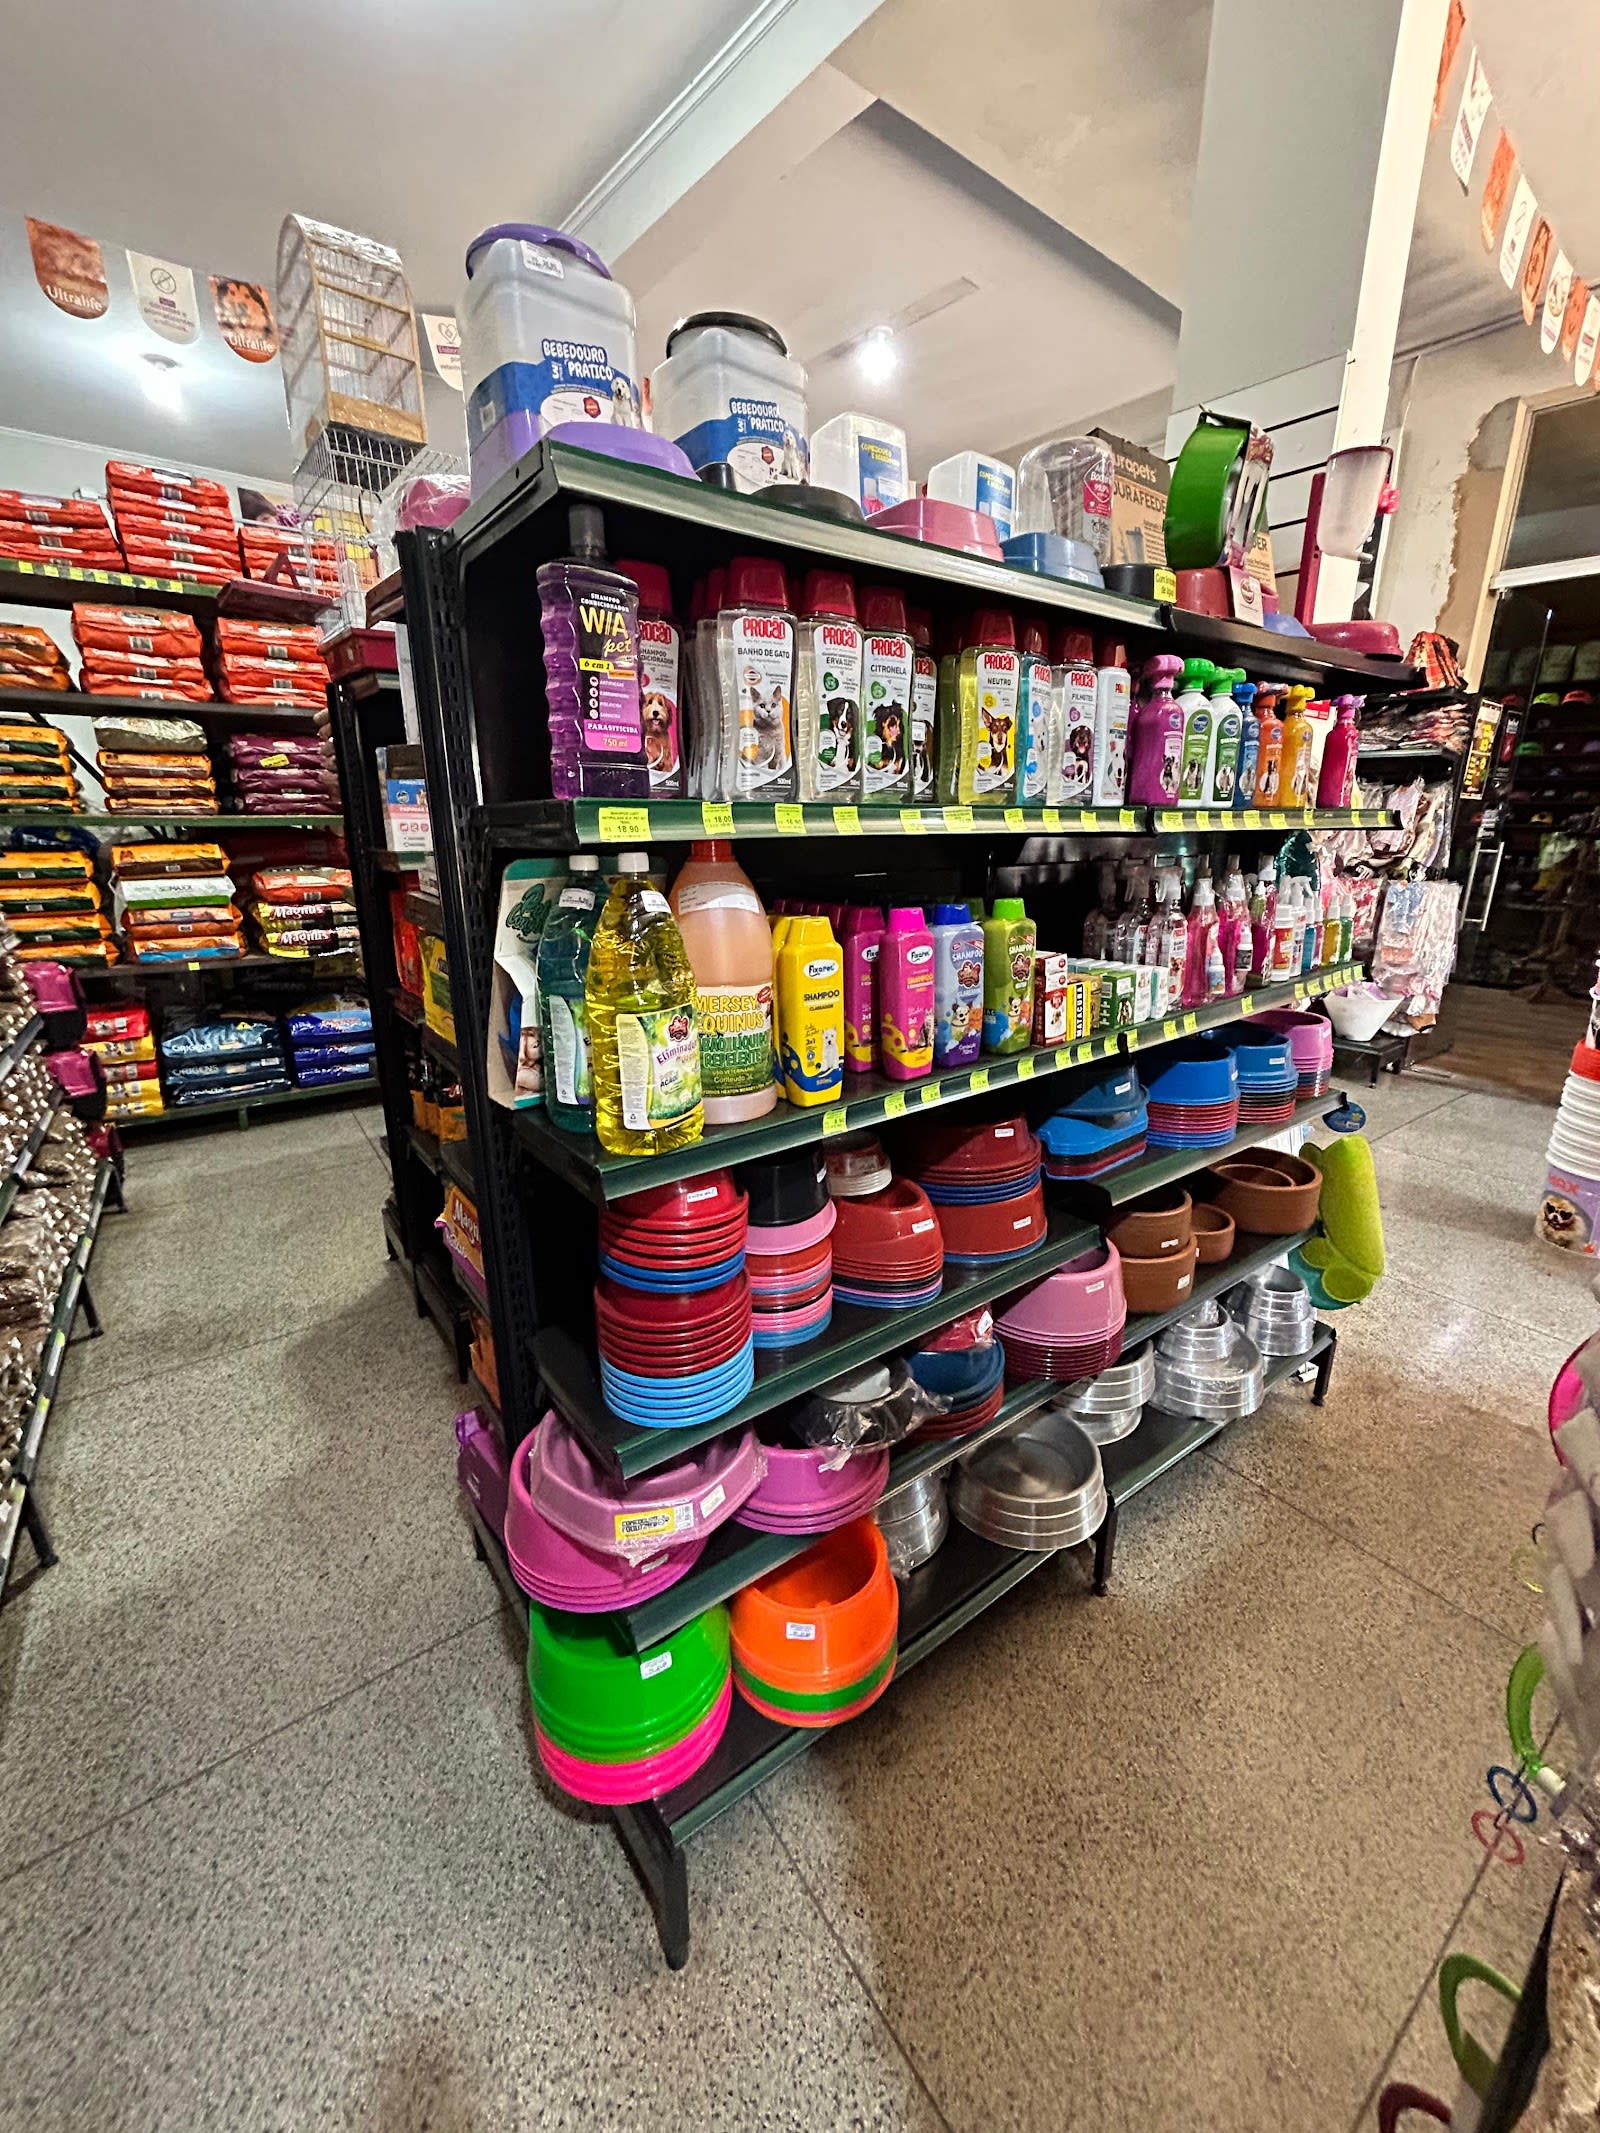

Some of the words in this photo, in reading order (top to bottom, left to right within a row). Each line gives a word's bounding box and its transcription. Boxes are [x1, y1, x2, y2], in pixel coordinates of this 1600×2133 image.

[46, 284, 103, 312] Ultralife
[229, 334, 275, 353] Ultralife
[543, 341, 606, 364] BEBEDOURO
[731, 401, 780, 416] BEBEDOURO
[1113, 455, 1157, 483] urapets
[591, 593, 620, 604] SHAMPOO
[580, 605, 628, 639] WIA
[604, 638, 632, 658] pet
[738, 647, 763, 656] BANHO
[765, 648, 774, 656] DE
[775, 649, 790, 659] GATO
[826, 656, 843, 665] ERVA
[870, 664, 907, 675] CITRONELA
[987, 677, 1011, 686] NEUTRO
[587, 723, 638, 734] PARASITICIDA
[269, 904, 324, 920] Magnus
[280, 930, 329, 946] Magnus
[952, 948, 983, 962] SHAMPOO
[1009, 943, 1034, 955] SHAMPOO
[803, 989, 840, 1002] SHAMPOO
[696, 994, 758, 1013] MERSEY
[704, 1050, 761, 1068] REPELENTE
